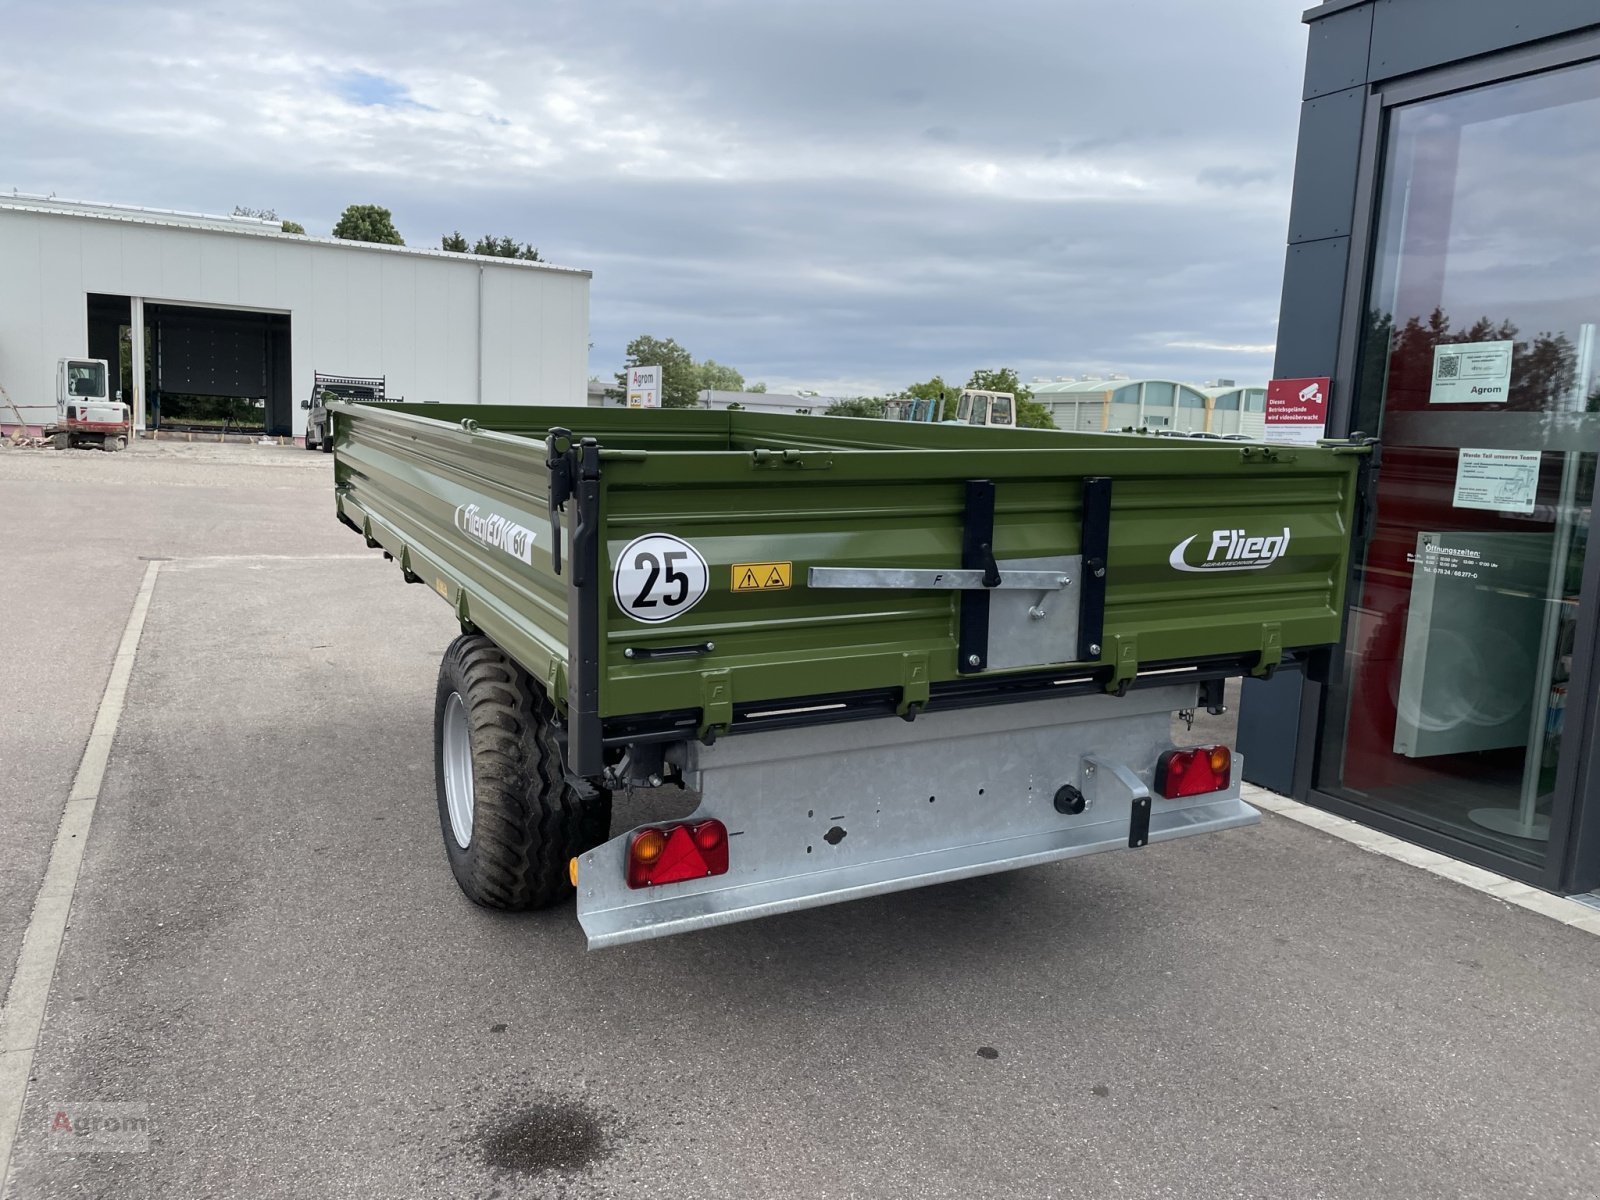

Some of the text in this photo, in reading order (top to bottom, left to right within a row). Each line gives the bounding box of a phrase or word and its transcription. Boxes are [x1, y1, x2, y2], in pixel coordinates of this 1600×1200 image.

[633, 371, 654, 387] Agrom
[1470, 386, 1502, 395] Agrom
[513, 530, 528, 558] 60
[1206, 527, 1291, 565] Fliegl
[1425, 543, 1481, 558] Öffnungszeiten:
[631, 552, 690, 609] 25
[933, 574, 943, 586] F
